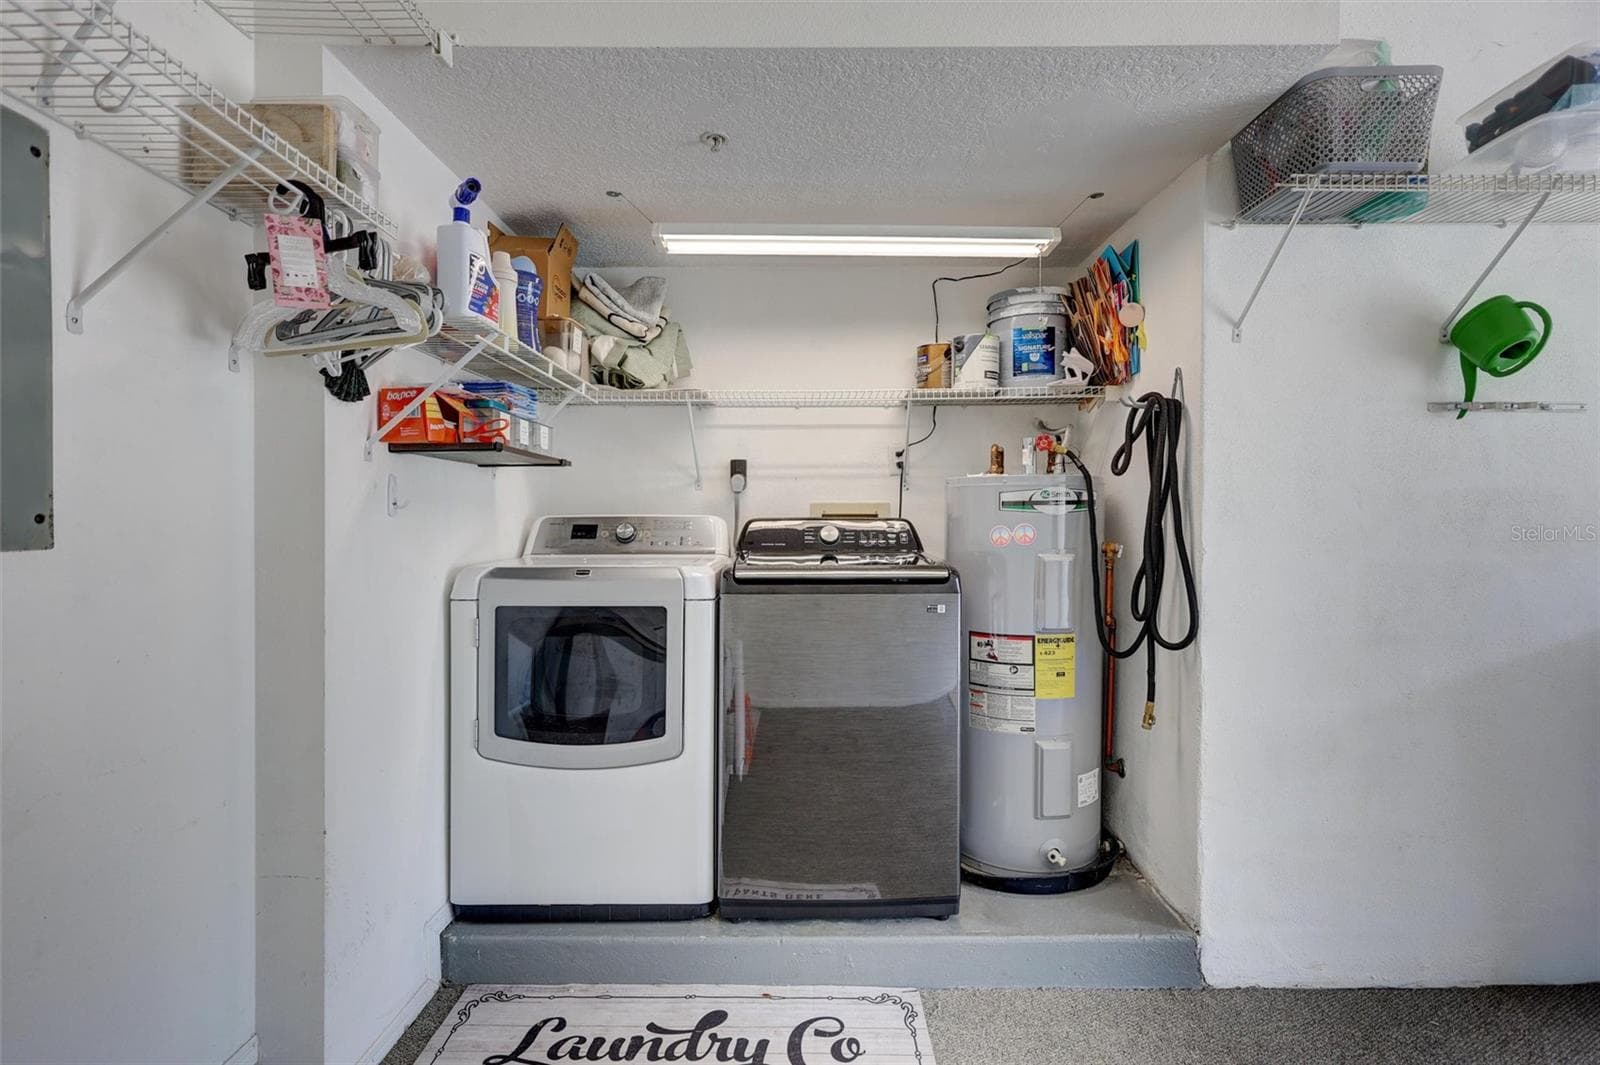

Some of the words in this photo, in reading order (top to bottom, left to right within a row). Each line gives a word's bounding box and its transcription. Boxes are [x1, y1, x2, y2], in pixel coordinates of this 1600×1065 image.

[386, 390, 417, 401] bounce
[483, 1009, 769, 1065] Laundry
[787, 1016, 866, 1065] Co
